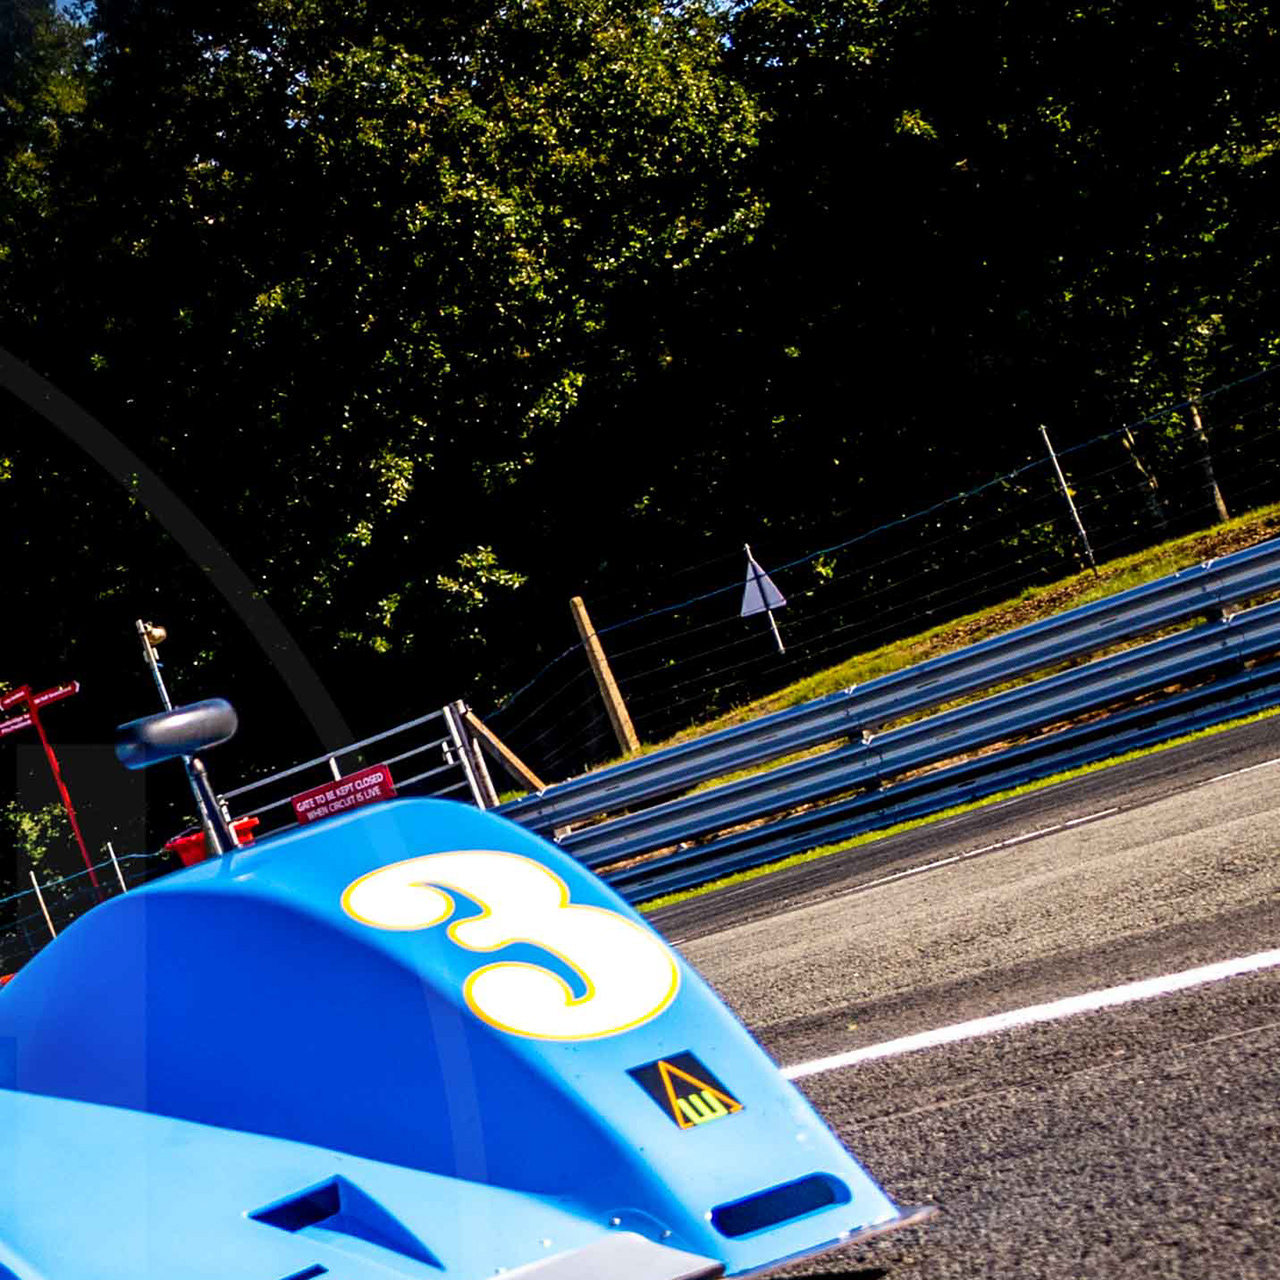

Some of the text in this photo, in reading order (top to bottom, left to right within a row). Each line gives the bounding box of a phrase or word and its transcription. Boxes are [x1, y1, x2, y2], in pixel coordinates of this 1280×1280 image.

[296, 772, 384, 812] GATE TO BE KEPT CLOSED
[306, 785, 381, 820] WHEN CIRCUIT IS LIVE
[341, 850, 681, 1041] 3
